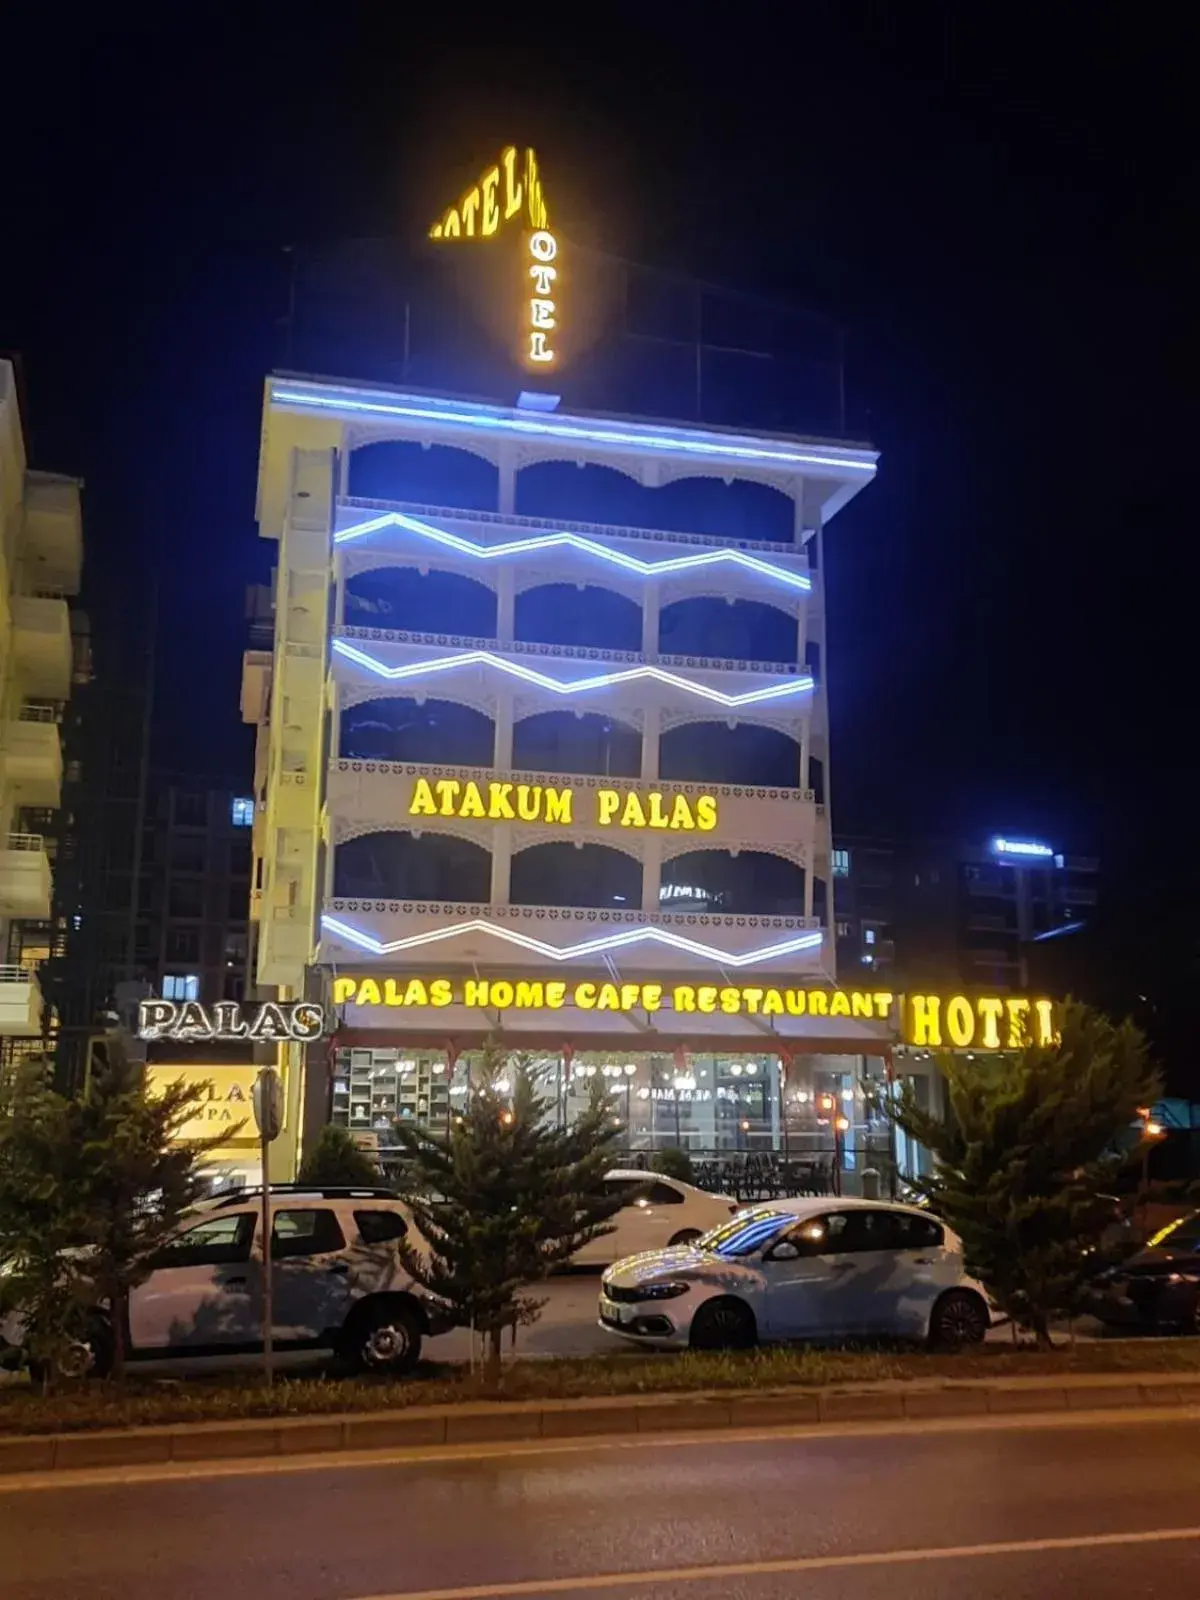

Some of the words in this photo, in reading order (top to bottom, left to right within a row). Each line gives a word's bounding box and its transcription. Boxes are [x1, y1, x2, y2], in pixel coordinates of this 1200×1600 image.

[408, 778, 573, 825] ATAKUM
[597, 789, 719, 832] PALAS
[333, 977, 453, 1007] PALAS
[464, 979, 567, 1010] HOME
[574, 982, 663, 1012] CAFE
[672, 985, 894, 1019] RESTAURANT
[138, 999, 323, 1041] PALAS
